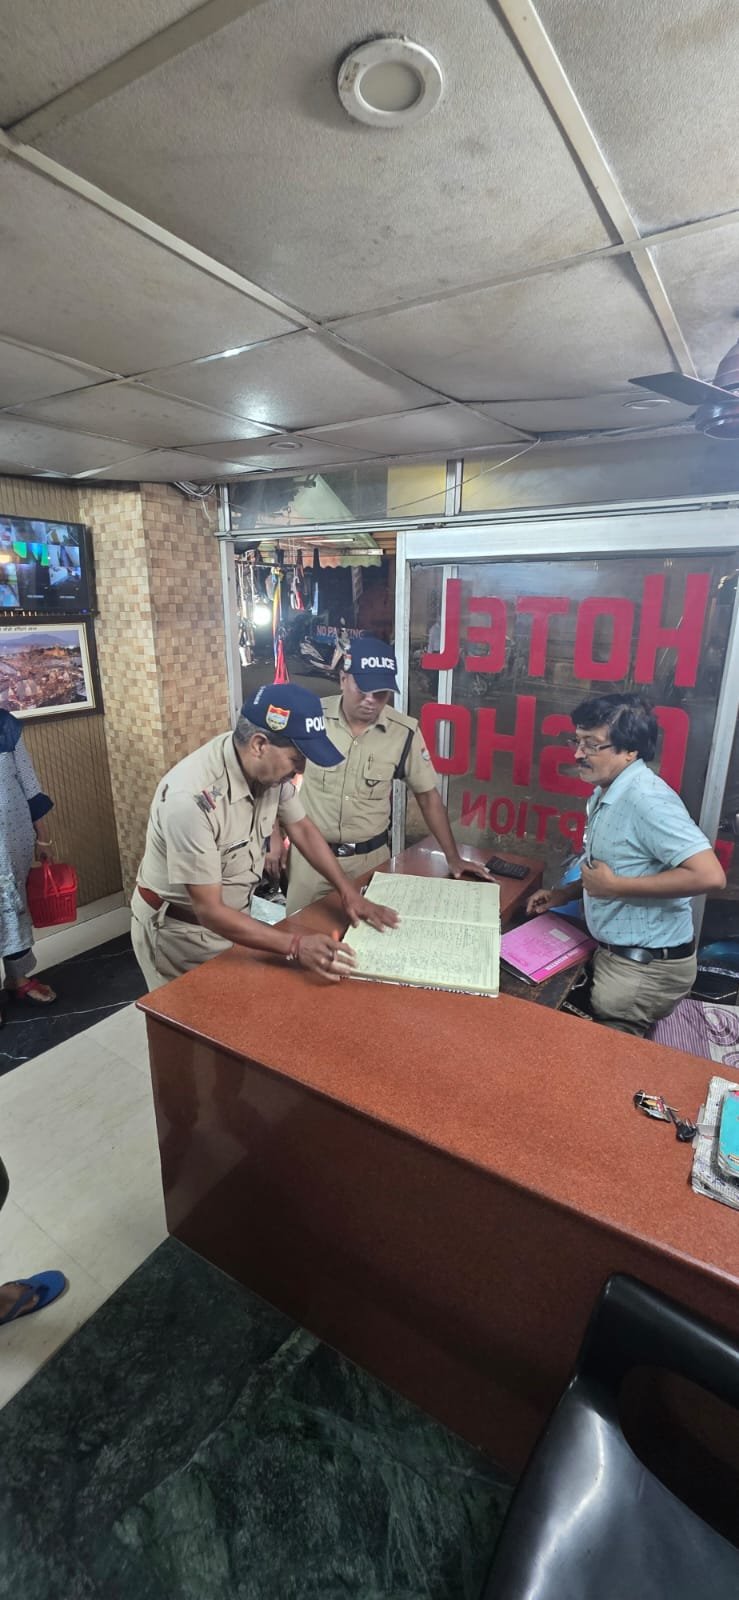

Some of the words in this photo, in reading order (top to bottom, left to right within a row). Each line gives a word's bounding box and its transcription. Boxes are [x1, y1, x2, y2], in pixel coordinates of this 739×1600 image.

[317, 625, 327, 637] NO
[327, 626, 365, 640] PAING
[360, 657, 395, 670] POLICE
